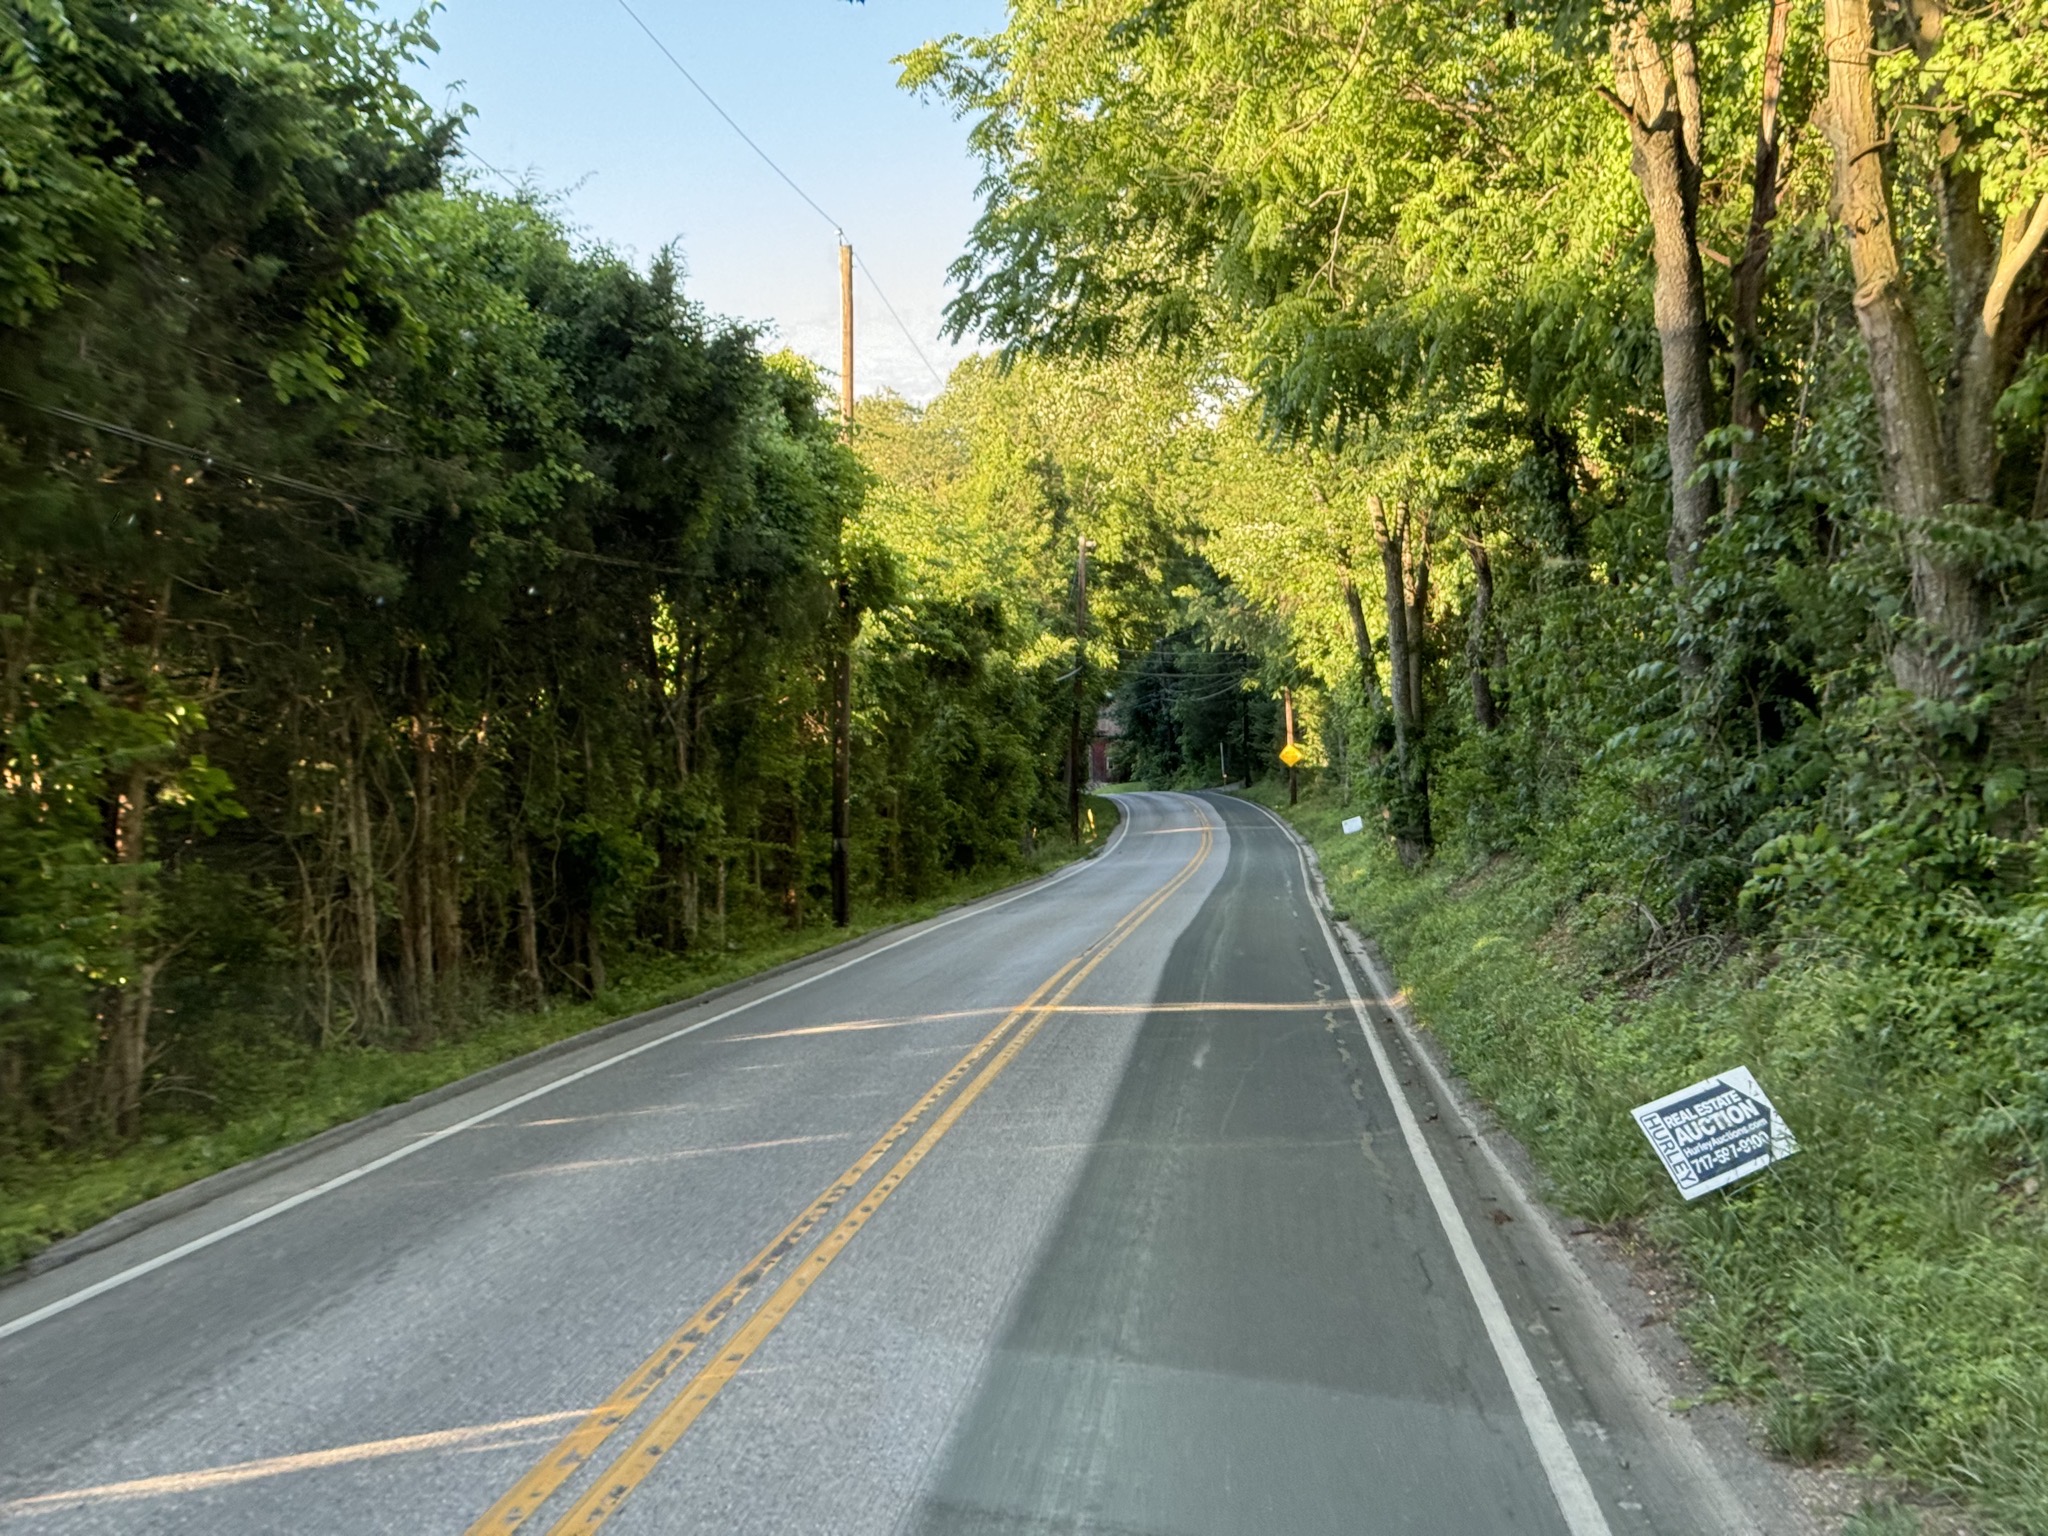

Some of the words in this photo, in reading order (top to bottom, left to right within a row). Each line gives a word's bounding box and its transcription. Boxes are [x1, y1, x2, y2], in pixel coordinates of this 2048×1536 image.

[1664, 1111, 1698, 1129] REAL
[1693, 1090, 1742, 1118] ESTATE
[1674, 1099, 1760, 1146] AUCTION
[1643, 1114, 1696, 1184] HURLEY
[1683, 1118, 1768, 1158] HurleyAuctions.com
